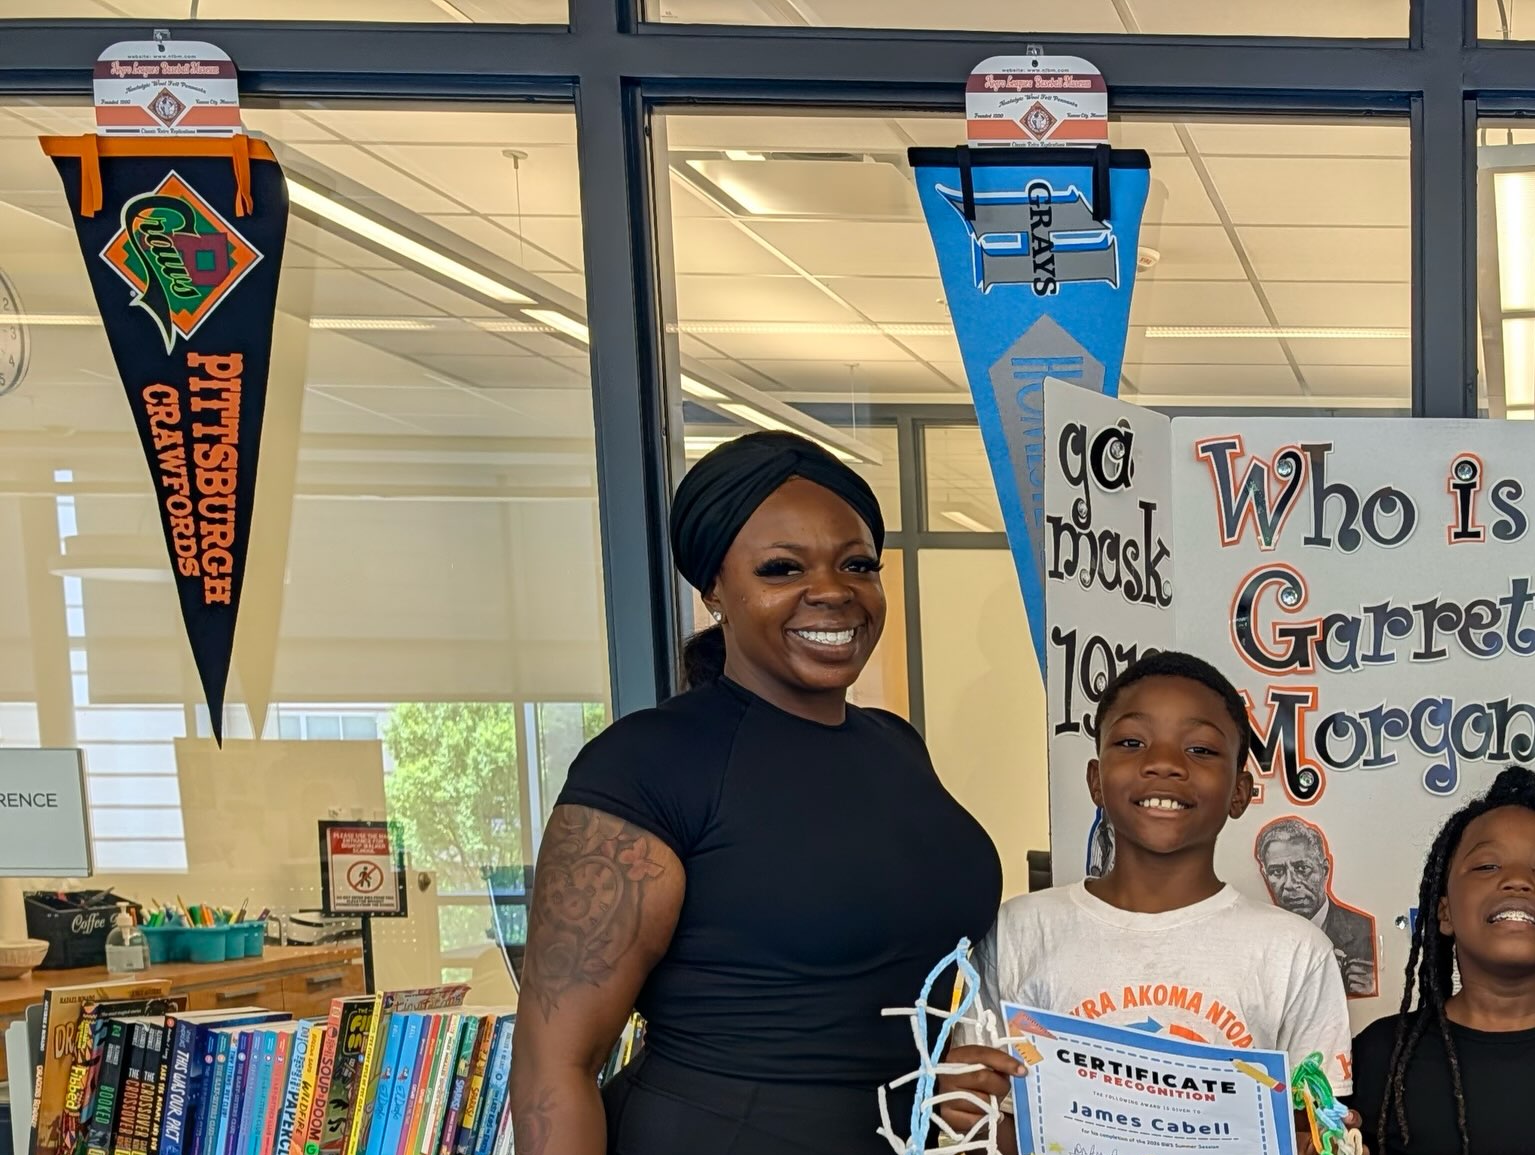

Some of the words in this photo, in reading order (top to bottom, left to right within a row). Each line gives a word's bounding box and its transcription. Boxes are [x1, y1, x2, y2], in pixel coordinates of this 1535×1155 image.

[1026, 180, 1059, 297] GRAYS
[142, 383, 200, 578] CRAWFORDS
[187, 352, 243, 605] PITTSBURGH
[1196, 435, 1416, 551] Who
[1448, 453, 1529, 545] is
[1047, 501, 1171, 607] mask
[71, 913, 106, 934] Coffee
[1122, 984, 1204, 1015] AKOMA
[128, 1067, 140, 1080] THE
[143, 1070, 155, 1082] THE
[174, 1050, 190, 1074] THIS
[318, 1057, 333, 1095] SOUP
[1056, 1048, 1237, 1095] CERTIFICATE
[65, 1065, 87, 1110] Fibbed
[171, 1073, 187, 1096] WAS
[1077, 1068, 1098, 1080] OF
[1103, 1075, 1217, 1102] RECOGNITION
[95, 1085, 115, 1125] BOOKED
[118, 1079, 140, 1135] CROSSOVER
[134, 1081, 155, 1138] CROSSOVER
[167, 1094, 185, 1118] OUR
[296, 1080, 312, 1135] WILDFIRE
[309, 1100, 326, 1141] DOOM
[1070, 1101, 1142, 1128] James
[1151, 1118, 1231, 1135] Cabell
[165, 1115, 182, 1144] PACT
